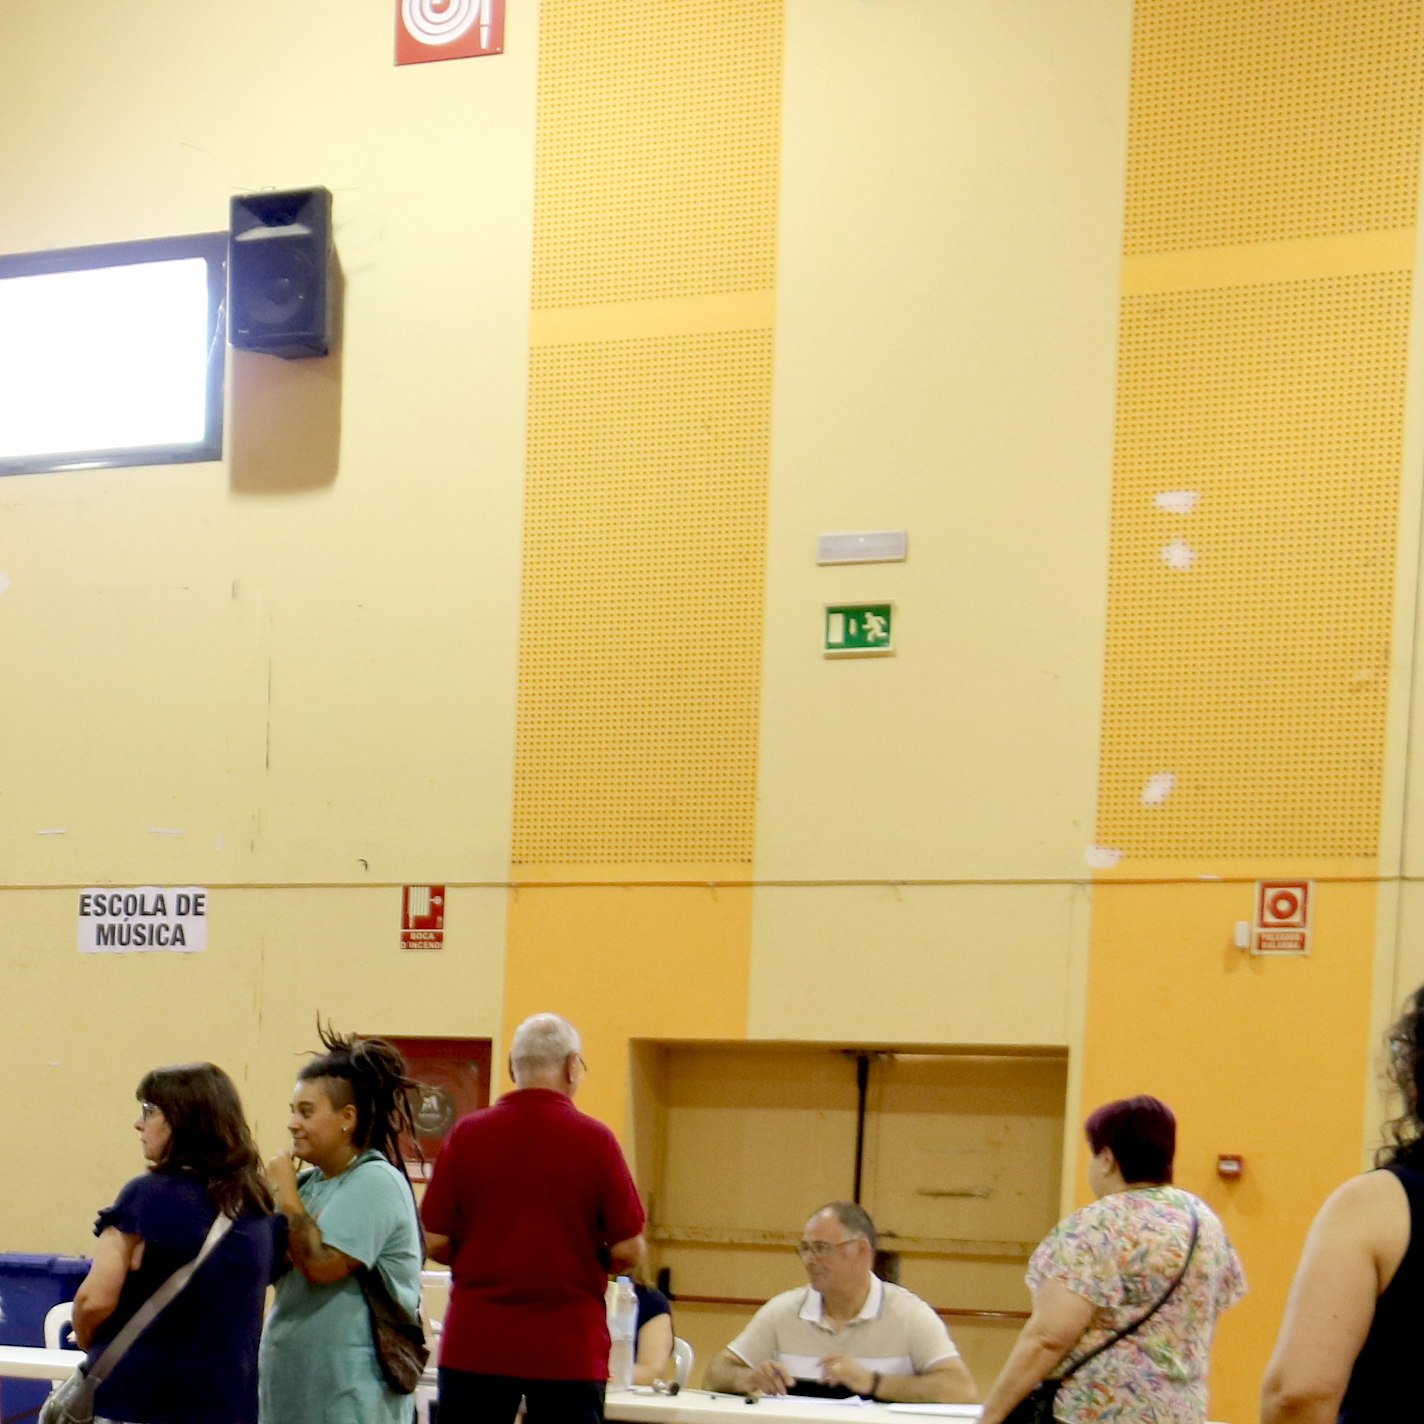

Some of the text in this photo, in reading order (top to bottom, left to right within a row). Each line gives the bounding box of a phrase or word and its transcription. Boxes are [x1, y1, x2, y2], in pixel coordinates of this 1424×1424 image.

[79, 893, 205, 917] ESCOLA DE
[95, 917, 186, 946] MÚSICA
[410, 932, 434, 940] BOCA
